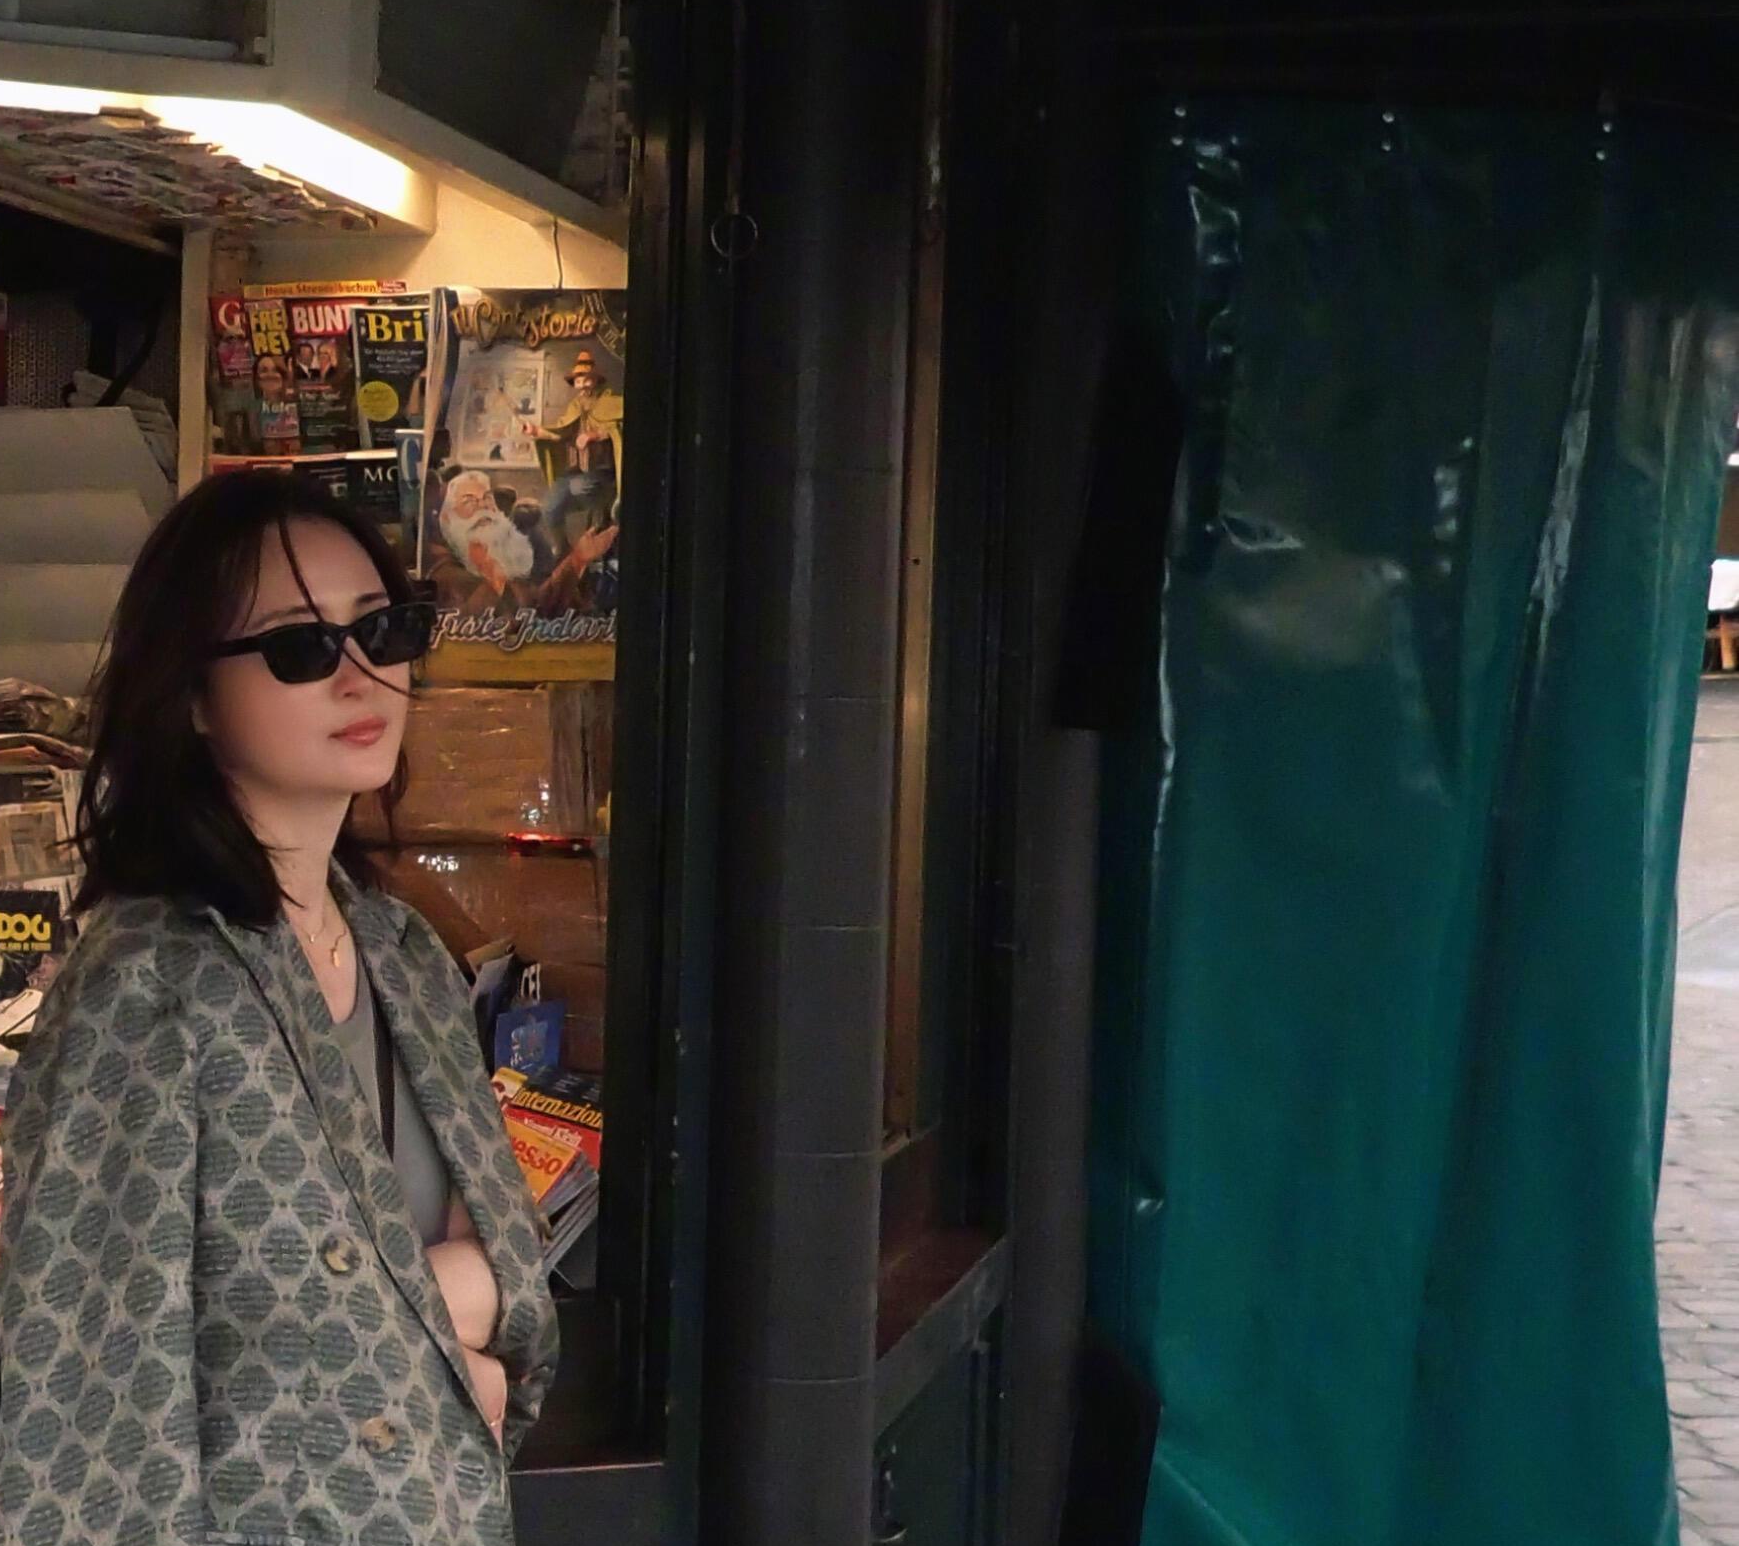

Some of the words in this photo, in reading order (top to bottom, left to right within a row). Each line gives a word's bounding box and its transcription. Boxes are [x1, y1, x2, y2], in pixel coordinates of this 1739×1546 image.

[292, 304, 351, 334] BUNT
[498, 607, 617, 652] Indovi
[511, 1088, 603, 1129] Internazion
